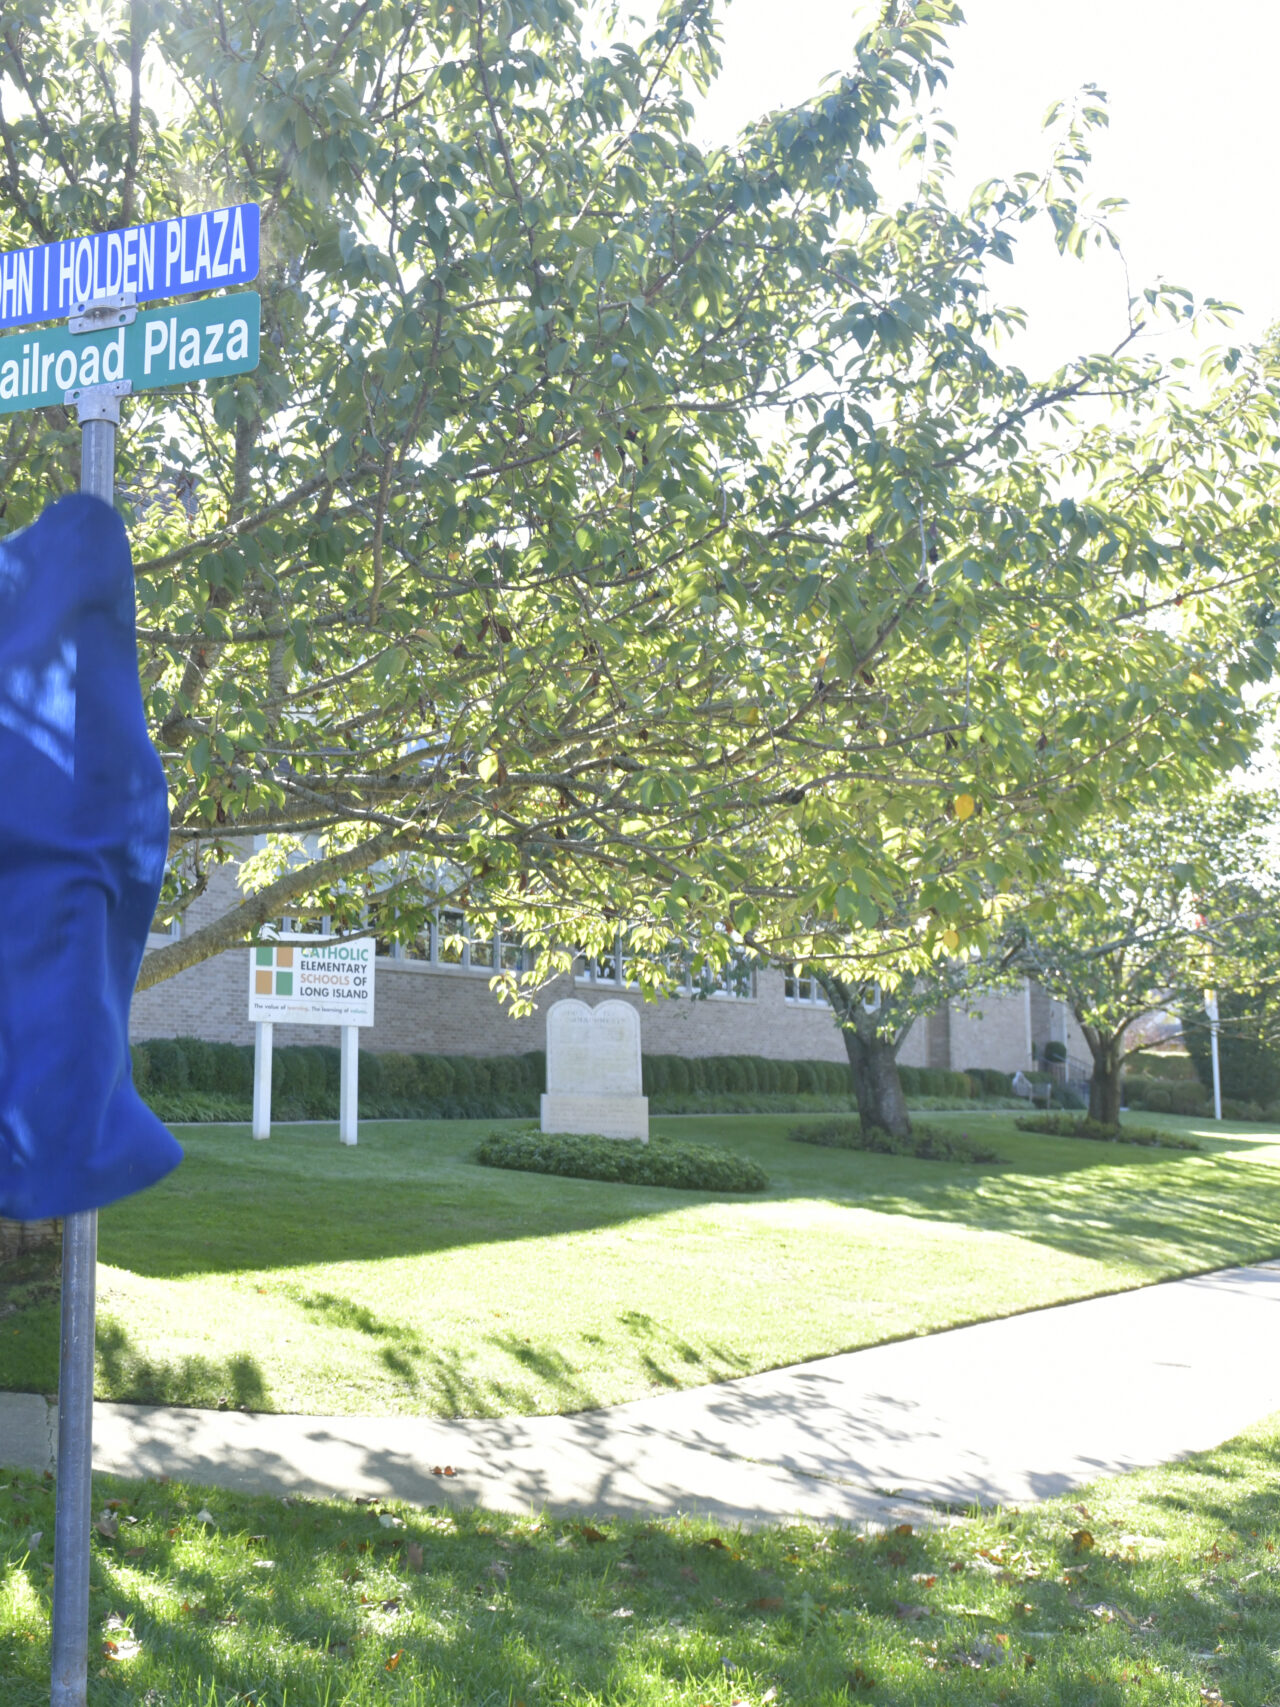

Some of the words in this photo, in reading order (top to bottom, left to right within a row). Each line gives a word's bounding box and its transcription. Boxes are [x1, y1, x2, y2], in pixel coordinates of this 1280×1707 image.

[43, 246, 49, 311] I
[59, 225, 156, 308] HOLDEN
[166, 207, 247, 287] PLAZA
[144, 317, 249, 375] Plaza
[301, 961, 367, 974] ELEMENTARY
[301, 974, 349, 986] SCHOOLS
[353, 976, 367, 986] OF
[300, 986, 329, 997] LONG
[332, 988, 368, 999] ISLAND
